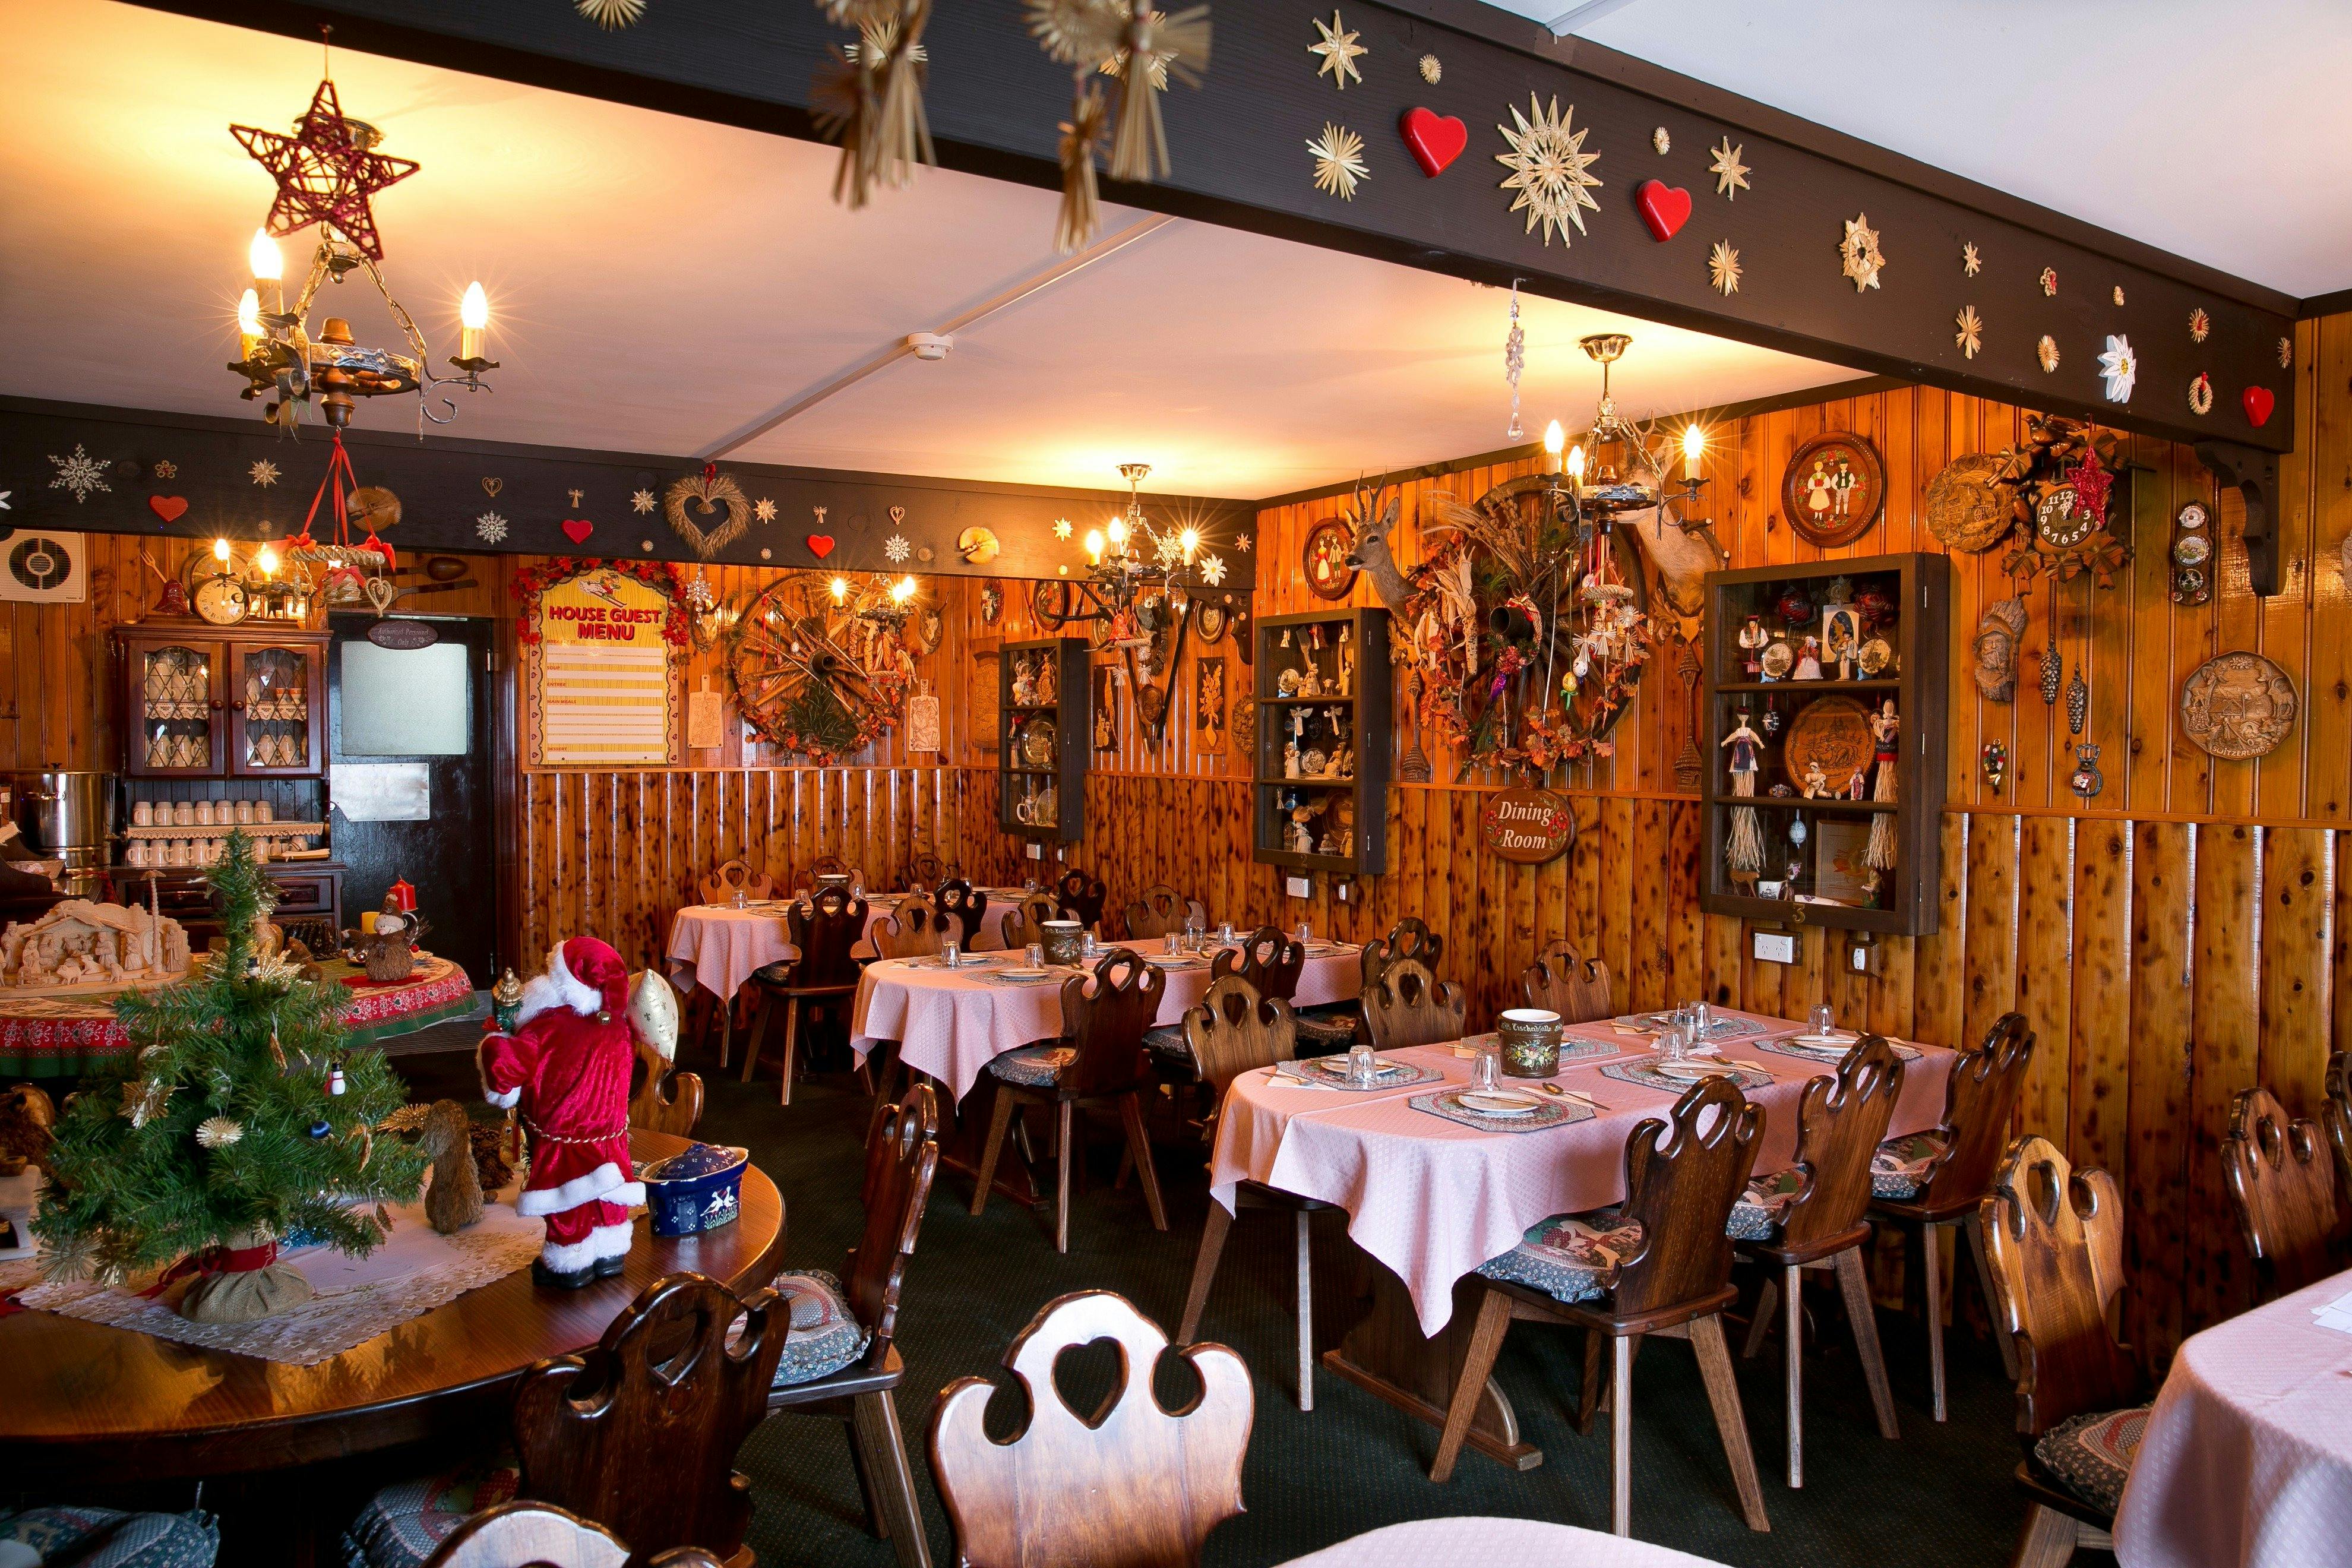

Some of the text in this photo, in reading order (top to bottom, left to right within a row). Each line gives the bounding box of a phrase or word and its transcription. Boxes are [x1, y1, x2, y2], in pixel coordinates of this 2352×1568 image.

[2048, 495, 2059, 505] 11
[2060, 491, 2072, 500] 12
[2041, 505, 2053, 514] 10
[2040, 515, 2048, 525] 9
[2083, 510, 2091, 520] 3
[2043, 526, 2050, 535] 8
[2080, 522, 2088, 532] 4
[2051, 533, 2059, 543] 7
[2061, 535, 2069, 544] 6
[2072, 531, 2079, 541] 5
[549, 605, 662, 624] HOUSE GUEST
[577, 622, 635, 641] MENU
[397, 638, 409, 647] Only
[2211, 745, 2266, 757] SWITZERLAND
[1498, 801, 1553, 827] Dining
[1501, 829, 1546, 849] Room
[1793, 903, 1806, 924] 3
